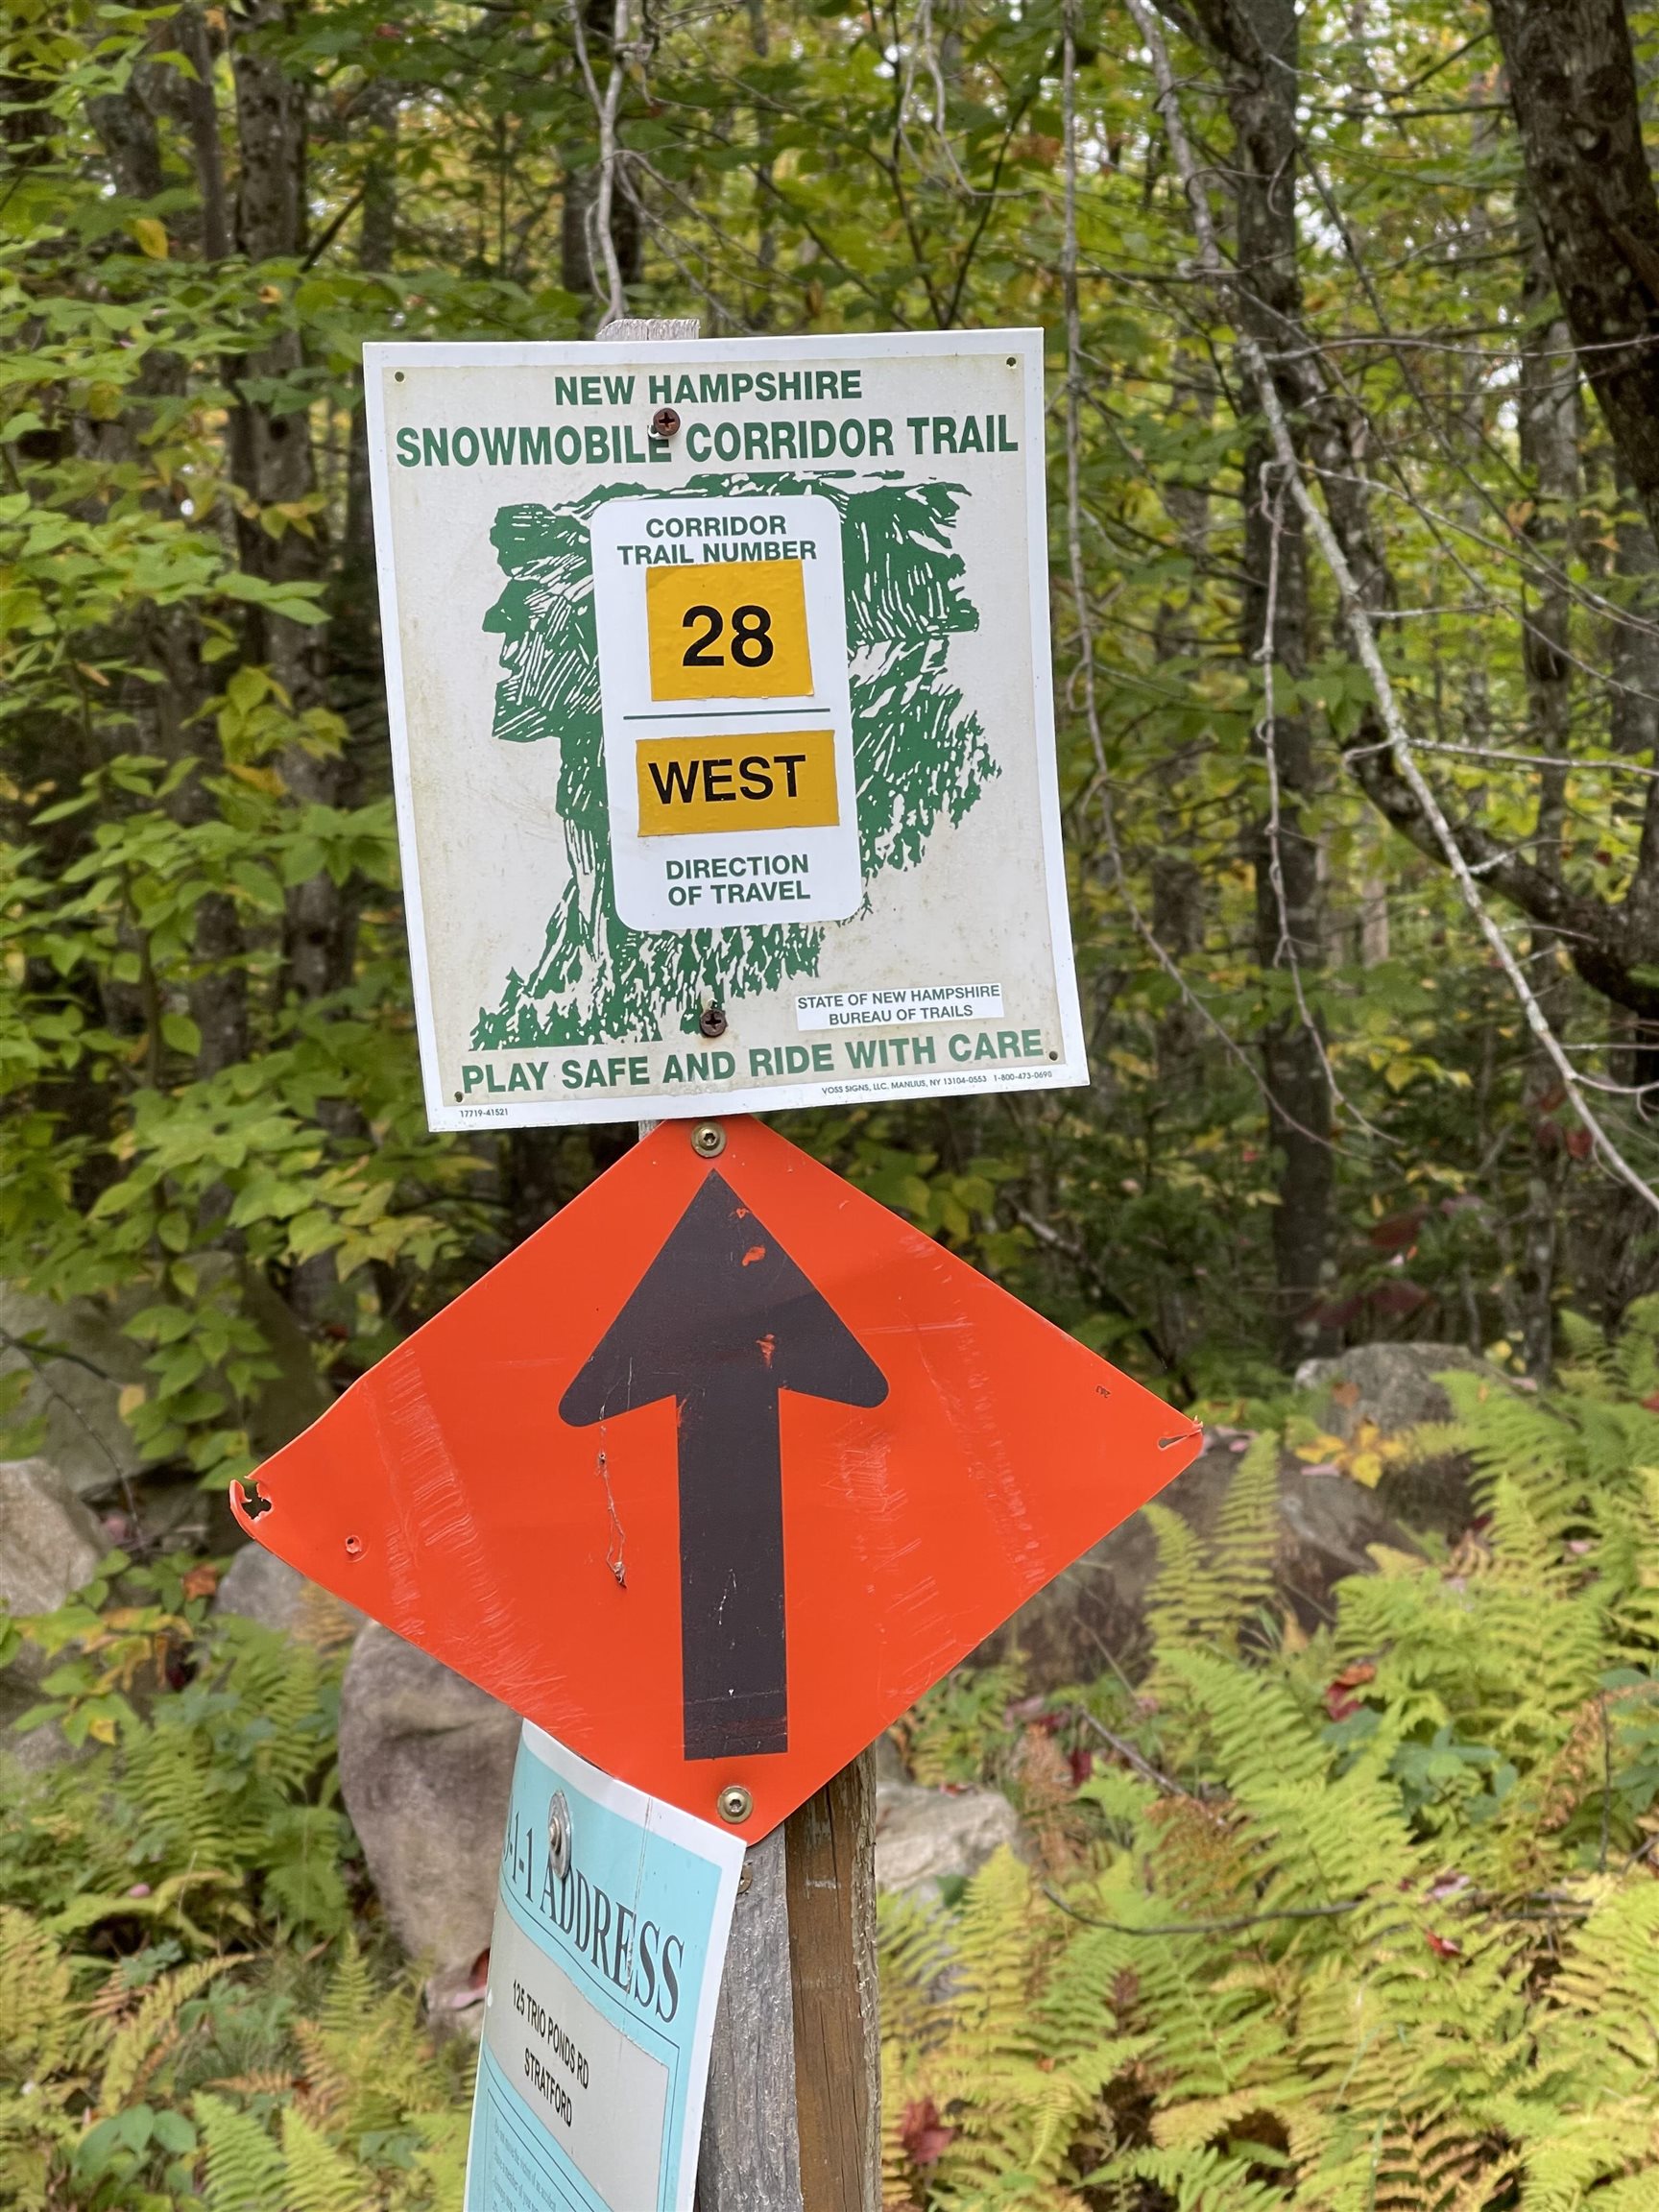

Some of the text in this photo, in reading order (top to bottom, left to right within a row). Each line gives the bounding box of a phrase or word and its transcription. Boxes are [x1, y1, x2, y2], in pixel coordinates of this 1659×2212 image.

[554, 370, 862, 405] NEW HAMPSHIRE
[397, 414, 1019, 468] SNOWMOBILE CORRIDOR TRAIL
[646, 515, 787, 538] CORRIDOR
[617, 540, 817, 565] TRAIL NUMBER
[682, 604, 774, 668] 28
[648, 755, 806, 805] WEST
[665, 854, 809, 880] DIRECTION
[668, 880, 810, 906] OF TRAVEL
[798, 985, 1000, 1010] STATE OF NEW HAMPSHIRE
[829, 1004, 974, 1025] BUREAU OF TRAILS
[462, 1028, 1045, 1094] PLAY SAFE AND RIDE WITH CARE
[822, 1085, 844, 1095] VOSS
[929, 1078, 941, 1087] NY
[943, 1075, 987, 1086] 13104-0553
[459, 1107, 509, 1118] 17719-41521
[539, 1849, 685, 2024] ADDRESS
[513, 1979, 589, 2090] 125 TRIO PONDS RD
[524, 2047, 573, 2128] STRATFORD
